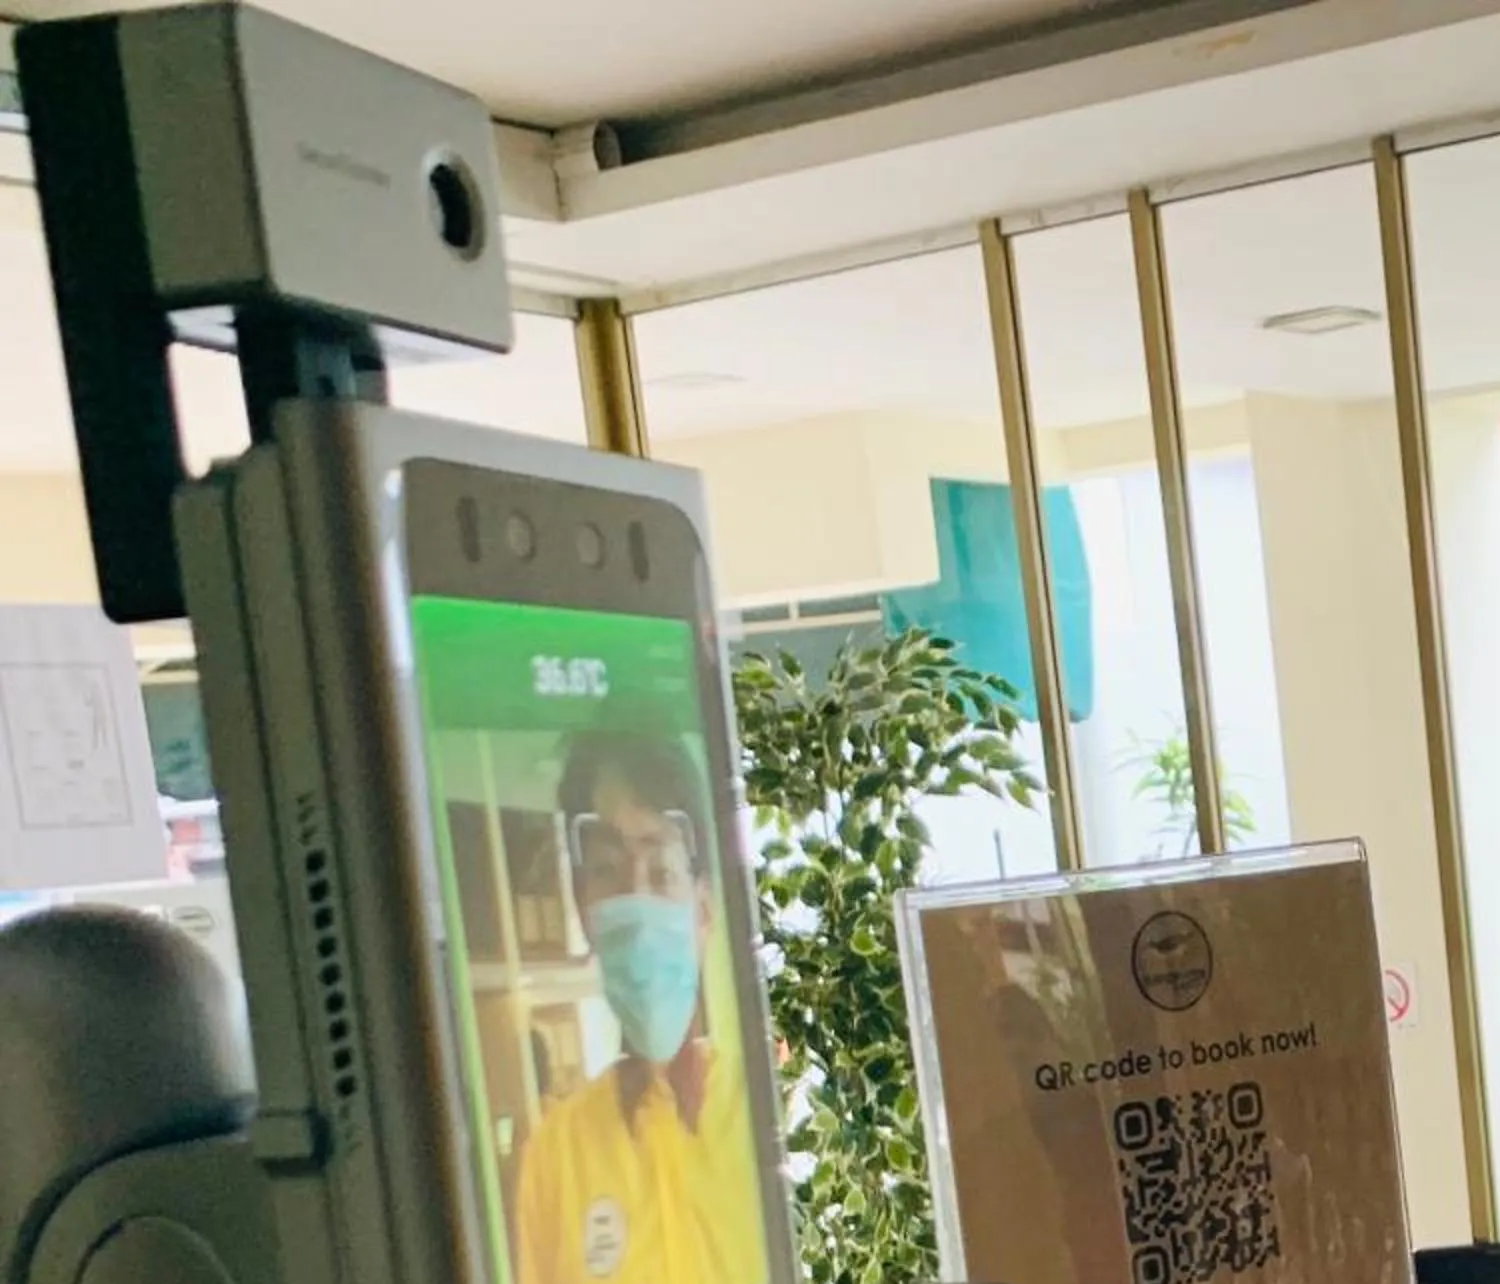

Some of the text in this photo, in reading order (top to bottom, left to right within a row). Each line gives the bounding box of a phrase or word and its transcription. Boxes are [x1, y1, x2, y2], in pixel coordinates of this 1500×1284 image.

[1035, 1022, 1317, 1091] QR code to book now!
